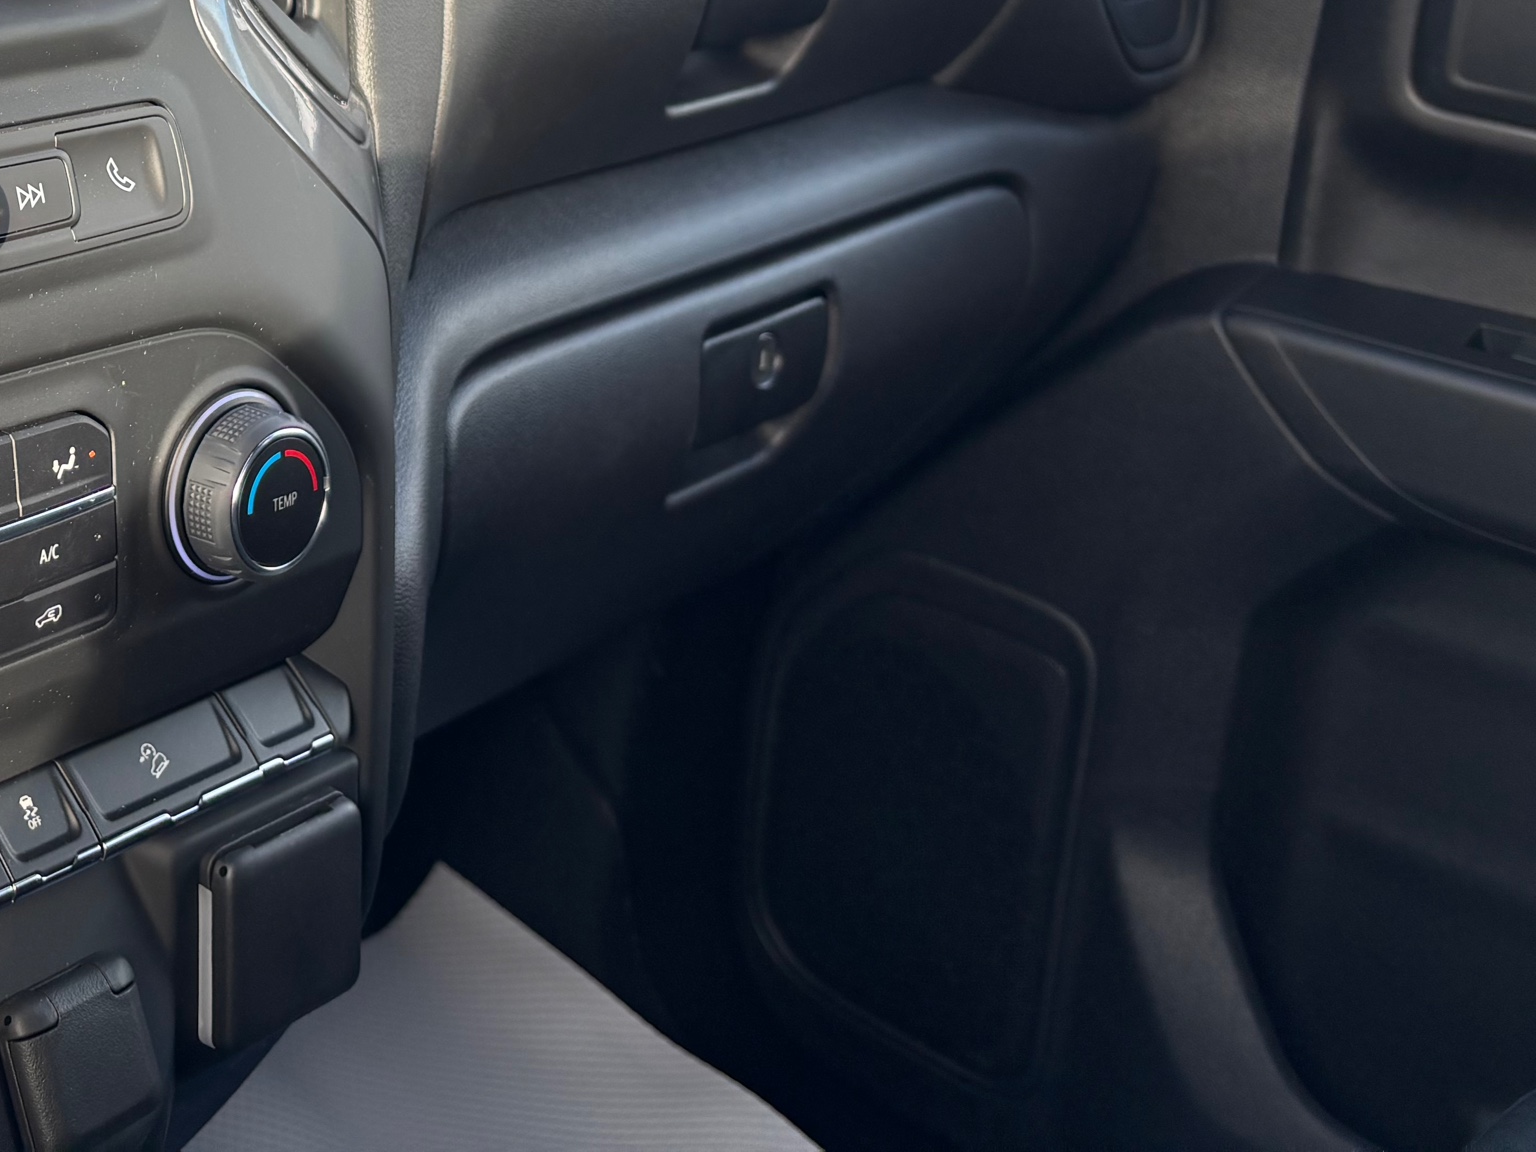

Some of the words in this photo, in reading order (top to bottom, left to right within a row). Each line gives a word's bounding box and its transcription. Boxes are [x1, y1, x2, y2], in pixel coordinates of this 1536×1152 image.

[272, 491, 298, 512] TEMP
[39, 543, 60, 565] A/C
[27, 815, 42, 830] OFF
